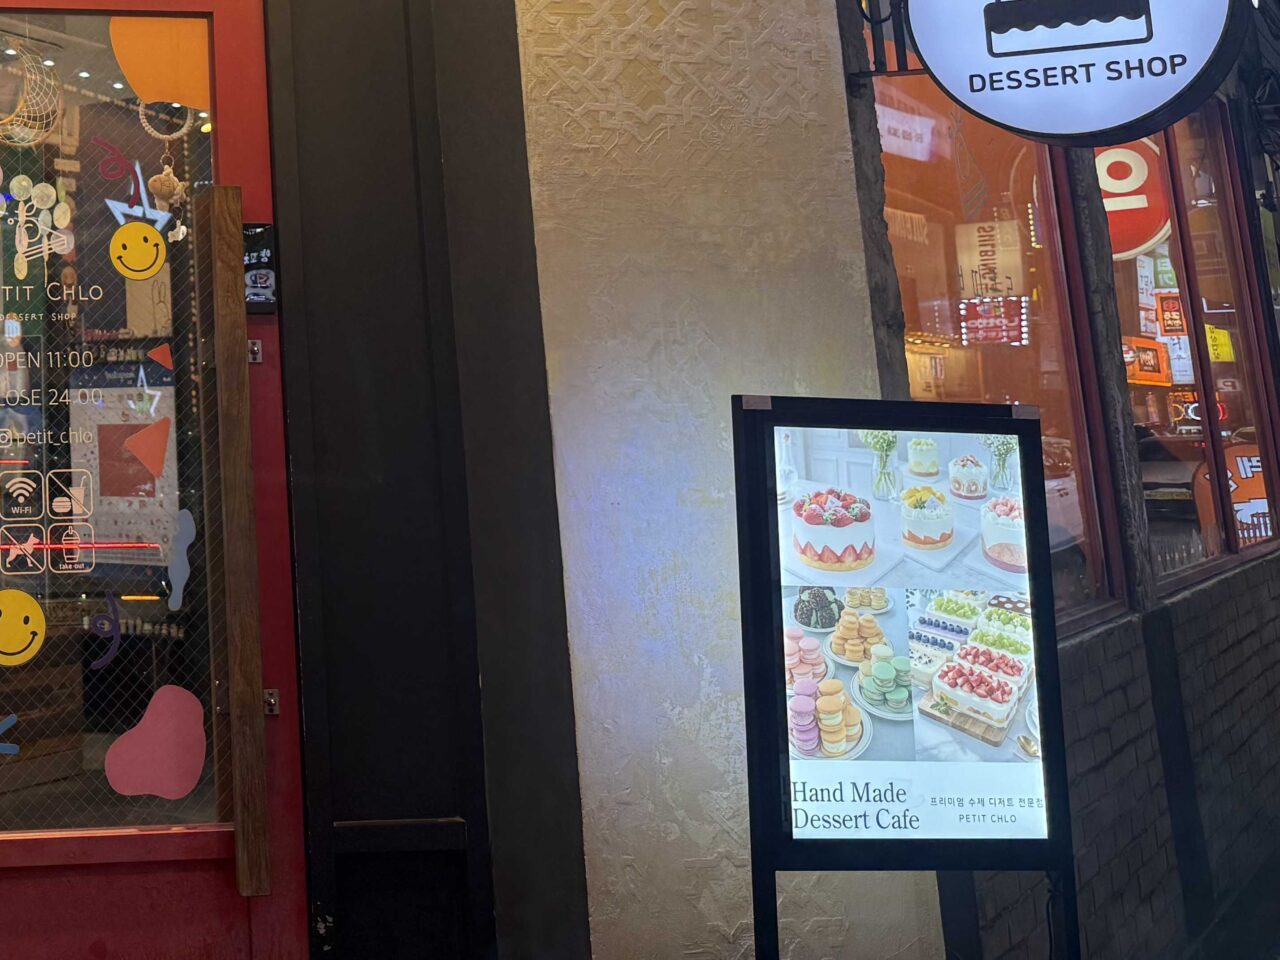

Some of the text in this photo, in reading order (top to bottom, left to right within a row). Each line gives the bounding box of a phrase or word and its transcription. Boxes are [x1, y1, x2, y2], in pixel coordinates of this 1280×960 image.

[968, 54, 1188, 94] DESSERT SHOP
[47, 351, 94, 368] 11:00
[792, 781, 908, 804] Hand Made
[793, 808, 920, 830] Dessert Cafe
[959, 814, 1017, 824] PETIT CHLO
